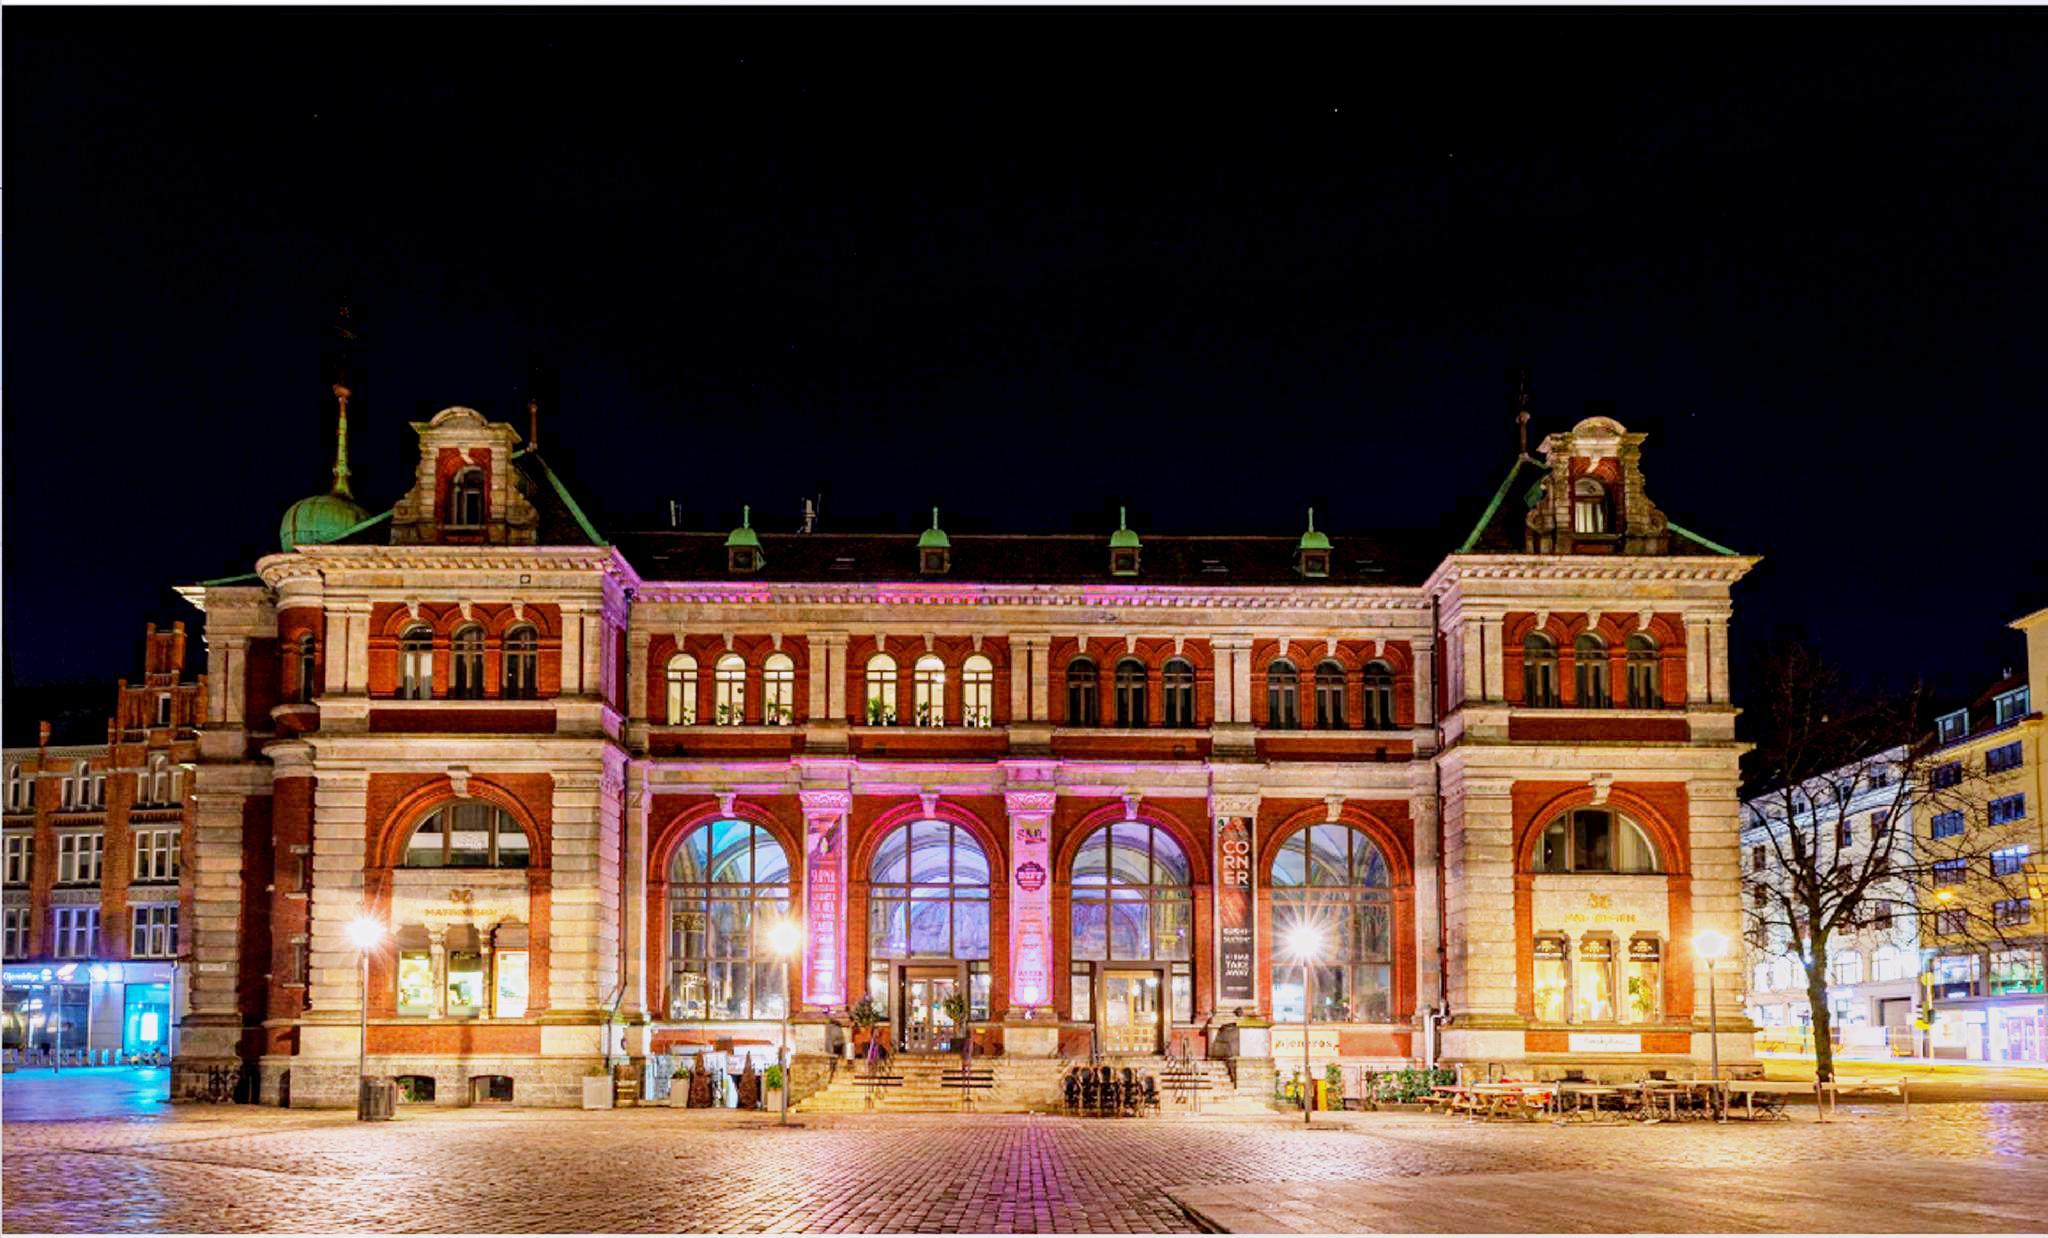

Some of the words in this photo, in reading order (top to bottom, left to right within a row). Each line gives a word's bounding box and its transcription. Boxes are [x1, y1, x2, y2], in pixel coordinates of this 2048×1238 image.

[1223, 840, 1249, 855] CO
[1223, 855, 1249, 869] RN
[1223, 871, 1249, 885] ER
